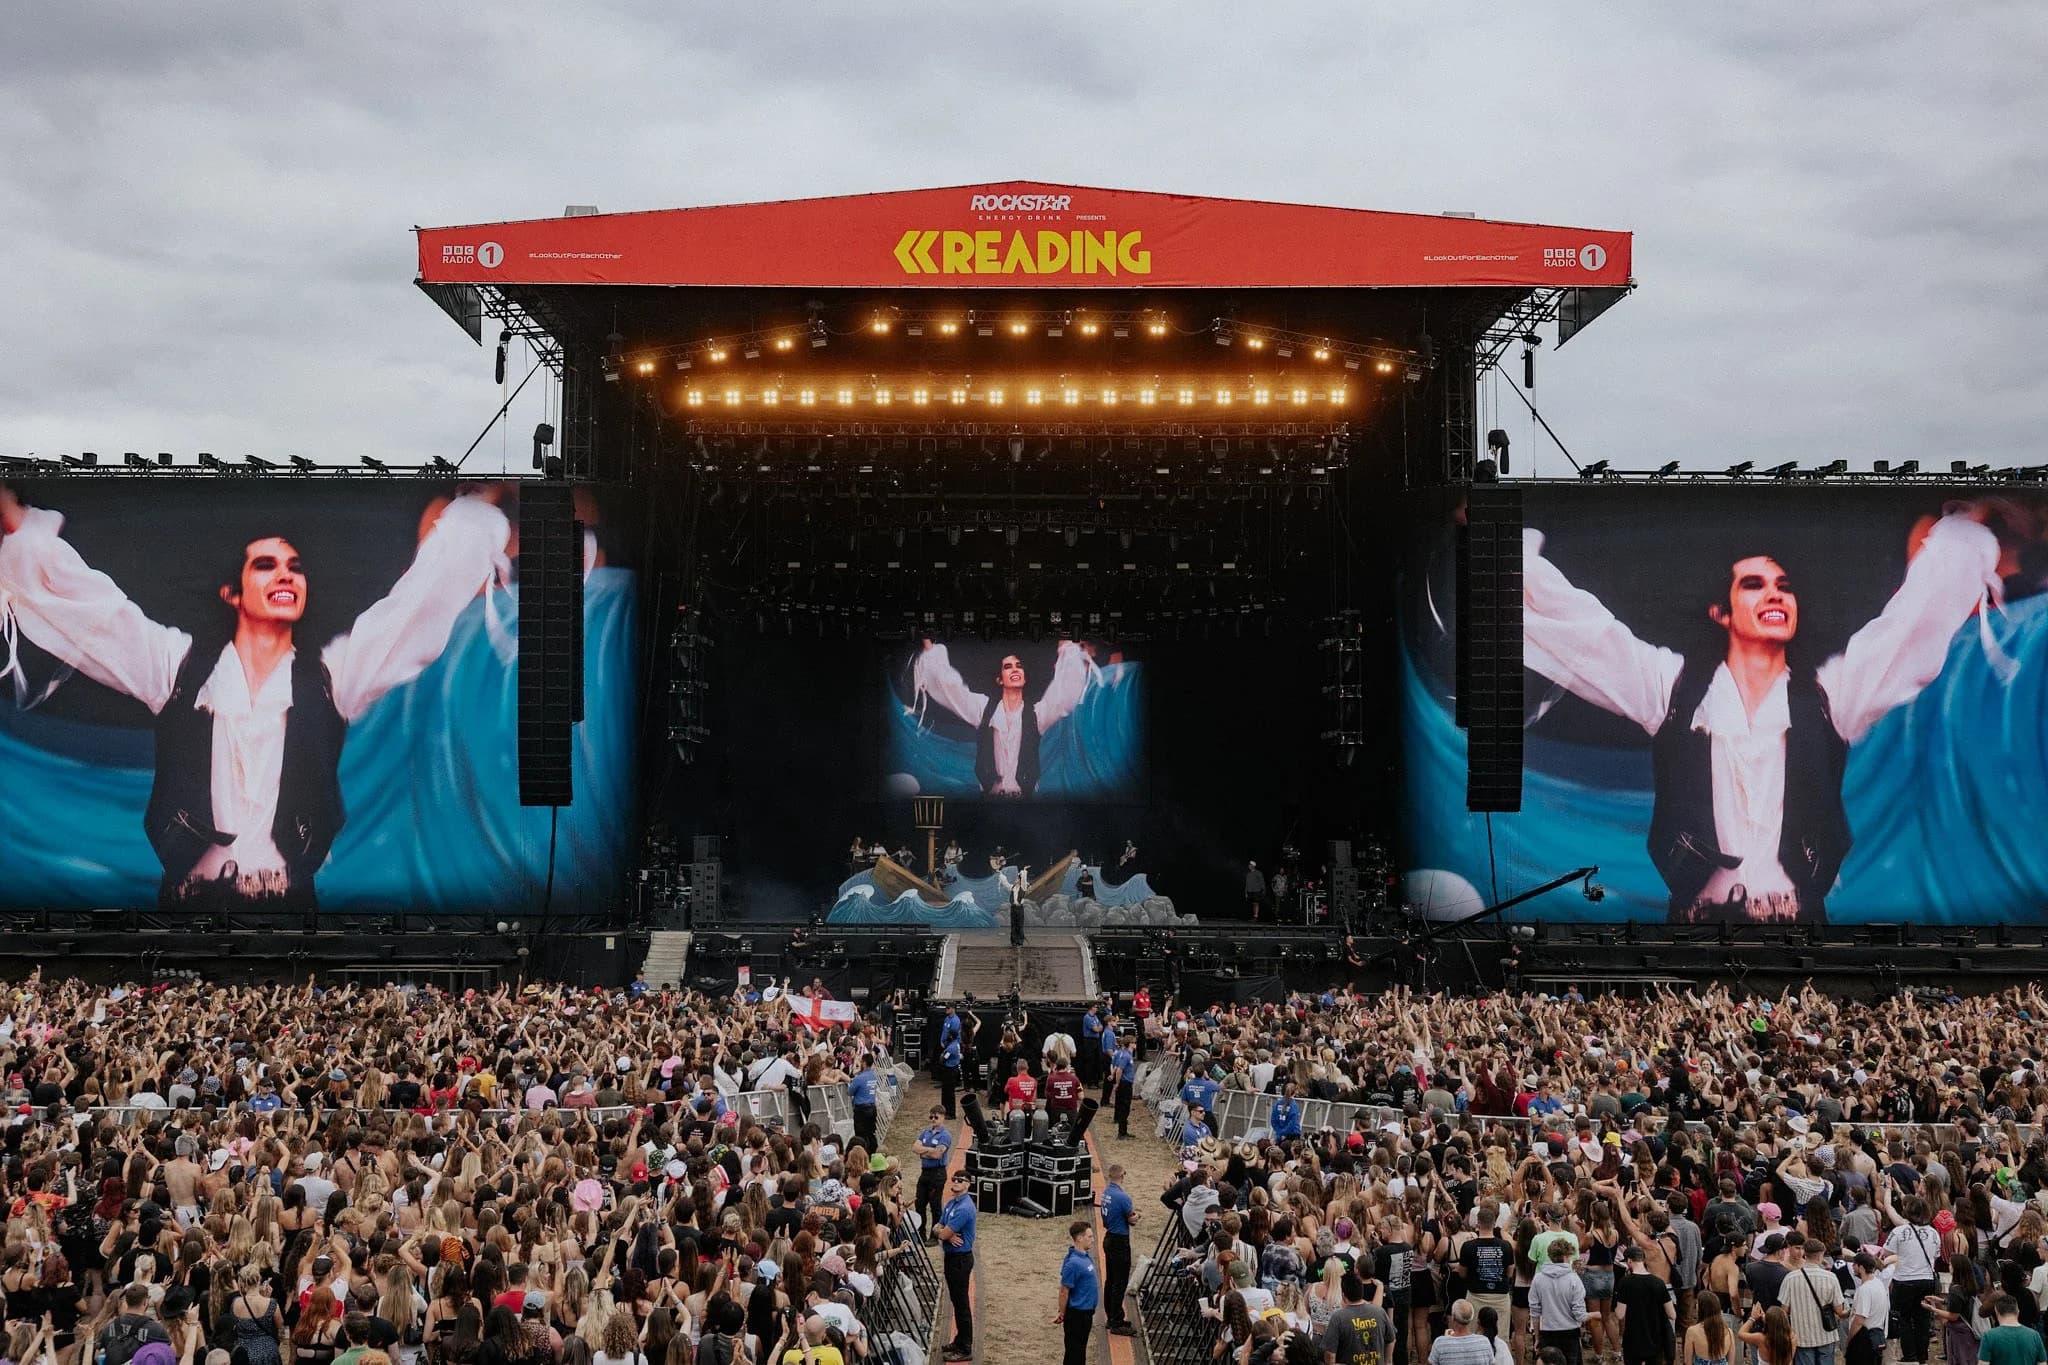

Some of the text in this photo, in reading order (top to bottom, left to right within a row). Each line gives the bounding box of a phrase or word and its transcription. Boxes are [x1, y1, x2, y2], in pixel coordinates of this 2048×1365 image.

[970, 194, 1073, 211] ROCKSTAR
[443, 246, 474, 255] BBC
[943, 230, 1151, 276] READING
[1544, 249, 1576, 258] BBC
[442, 255, 474, 264] RADIO
[1544, 258, 1577, 267] RADIO
[1351, 1317, 1377, 1331] Vans
